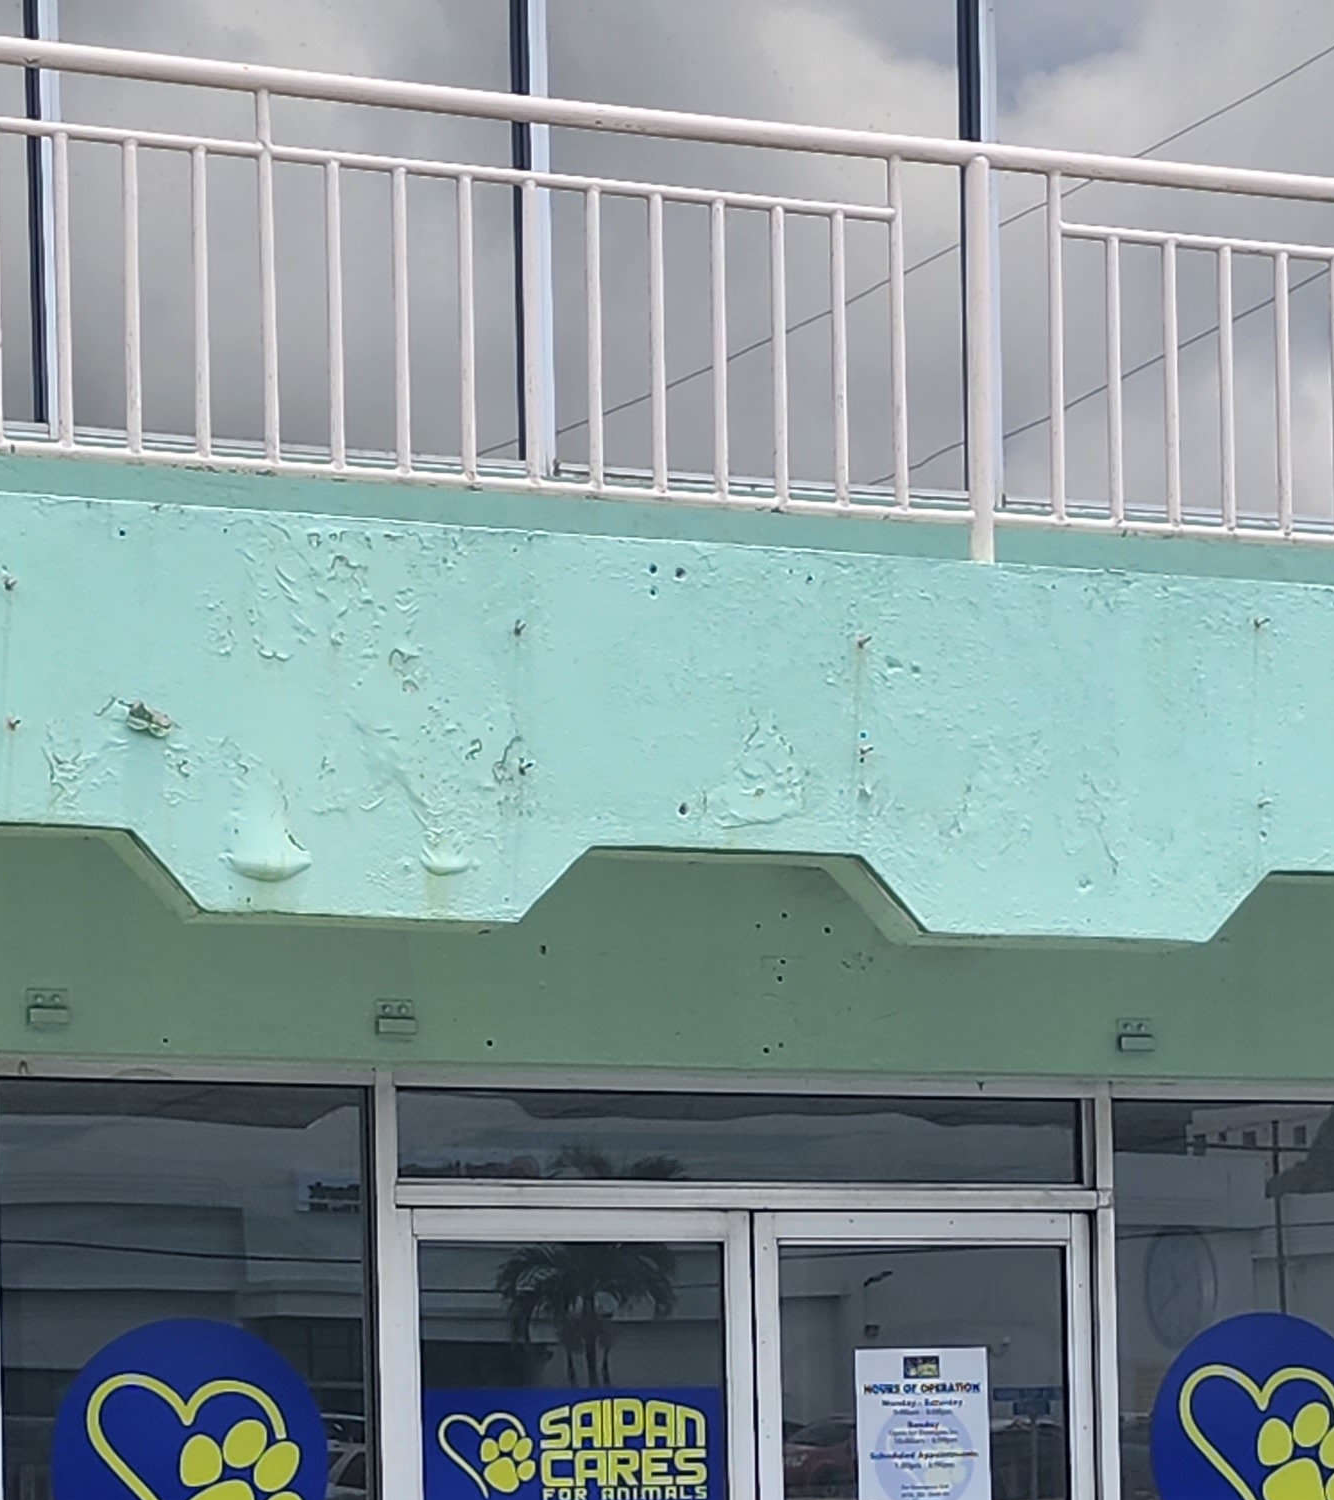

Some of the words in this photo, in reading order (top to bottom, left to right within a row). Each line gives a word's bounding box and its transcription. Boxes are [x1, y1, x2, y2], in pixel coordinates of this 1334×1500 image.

[863, 1383, 900, 1395] HOURS
[903, 1383, 917, 1394] OF
[920, 1381, 981, 1394] OPERATION
[539, 1398, 707, 1449] SAIPAN
[540, 1449, 708, 1486] CARES
[601, 1485, 708, 1500] ANIMALS
